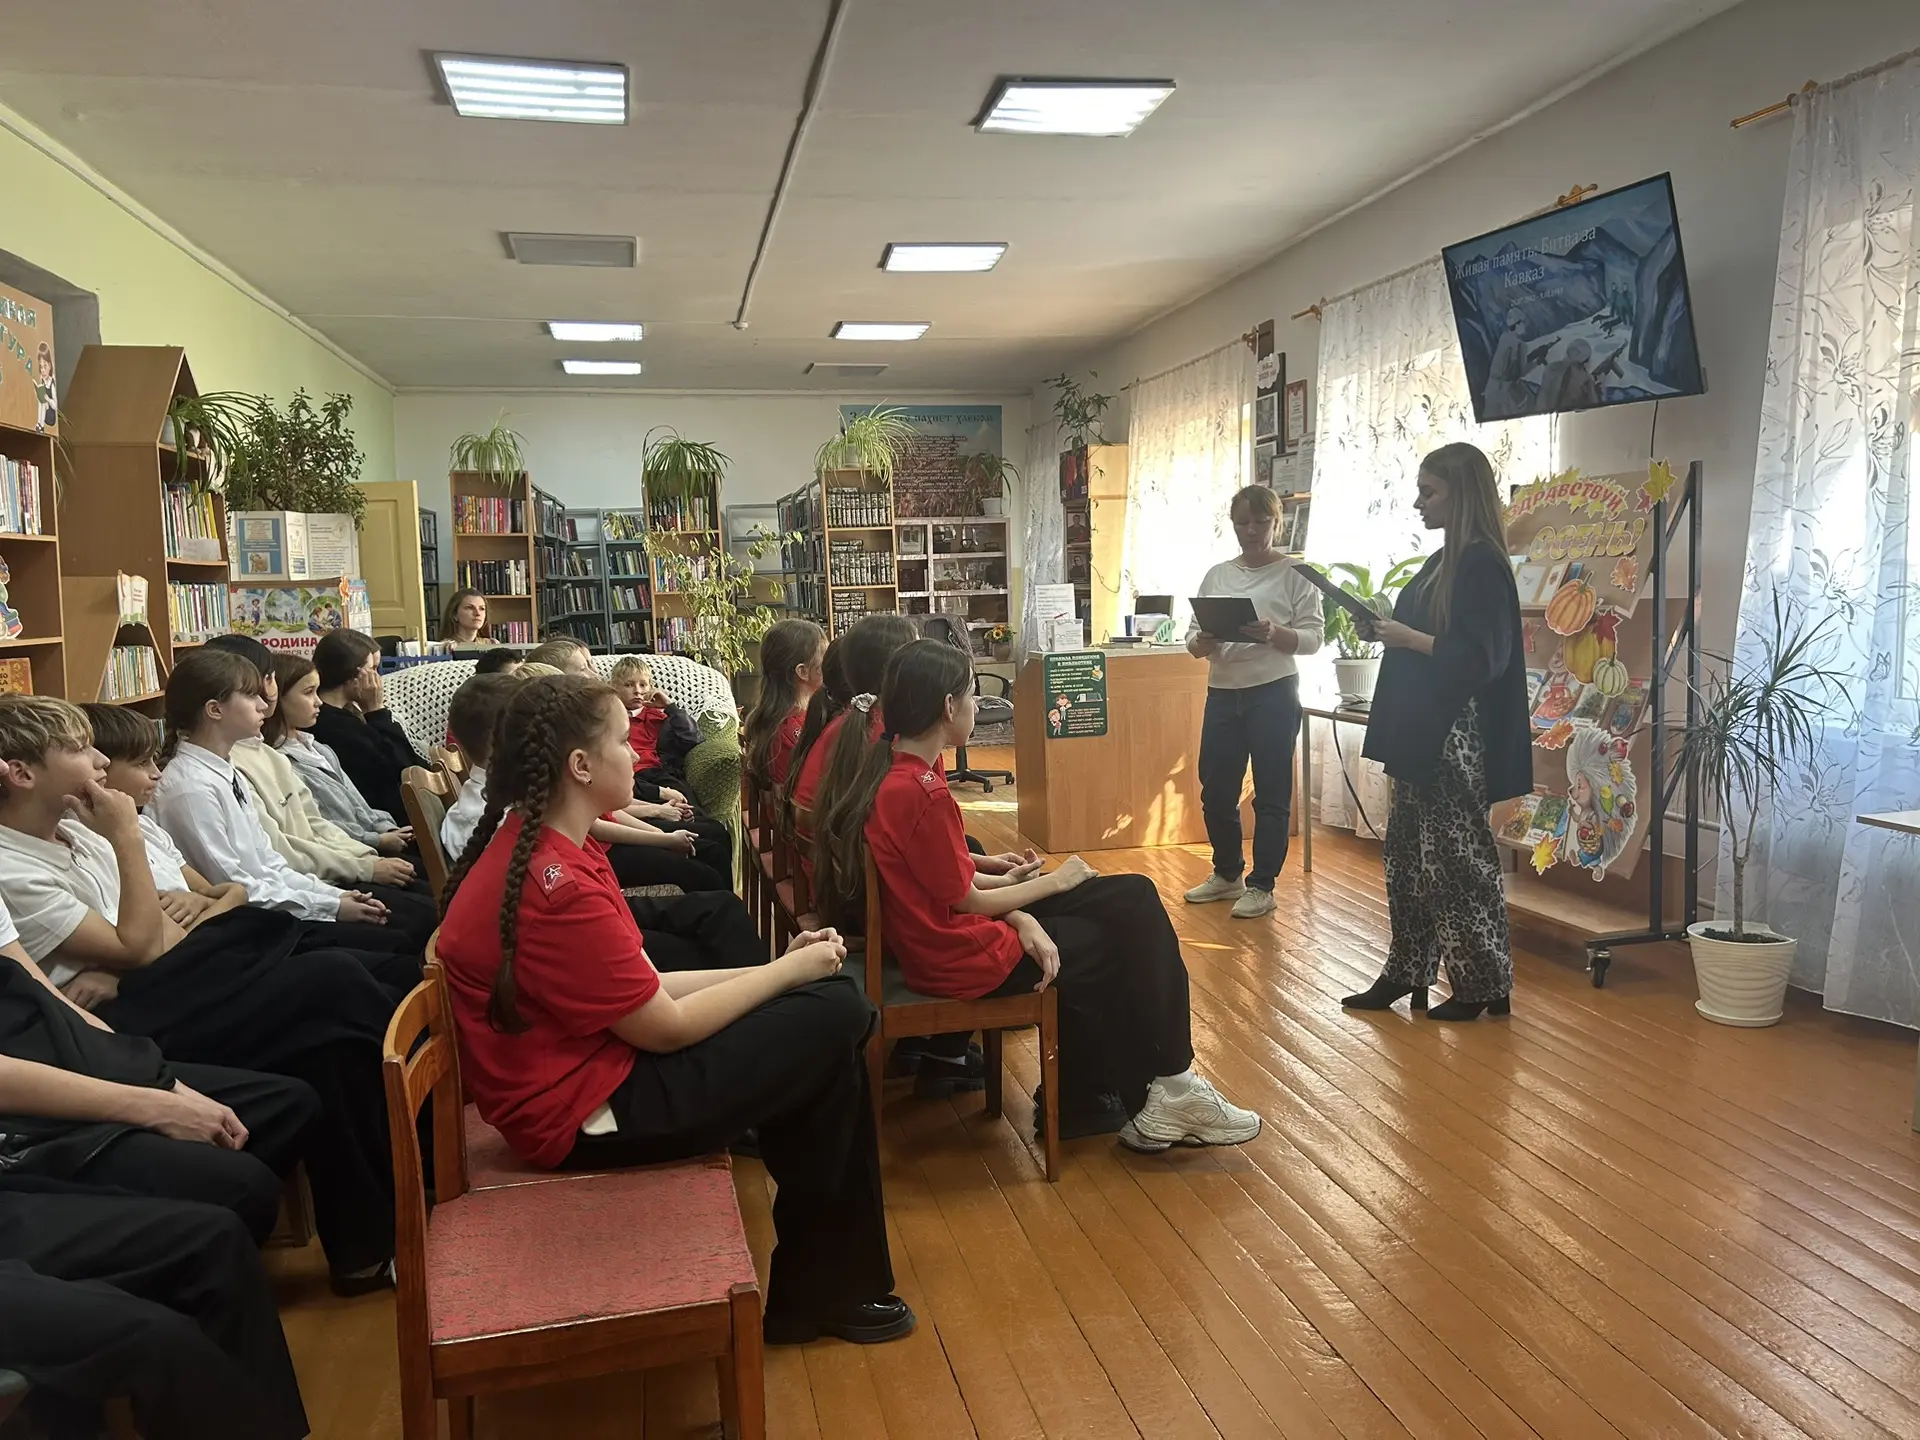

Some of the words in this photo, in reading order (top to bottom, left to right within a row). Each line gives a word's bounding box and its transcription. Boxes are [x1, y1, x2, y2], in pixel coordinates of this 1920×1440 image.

[1454, 260, 1490, 280] Живая
[1581, 226, 1596, 243] за
[1504, 266, 1545, 288] Кавказ
[261, 637, 318, 649] РОДИНА
